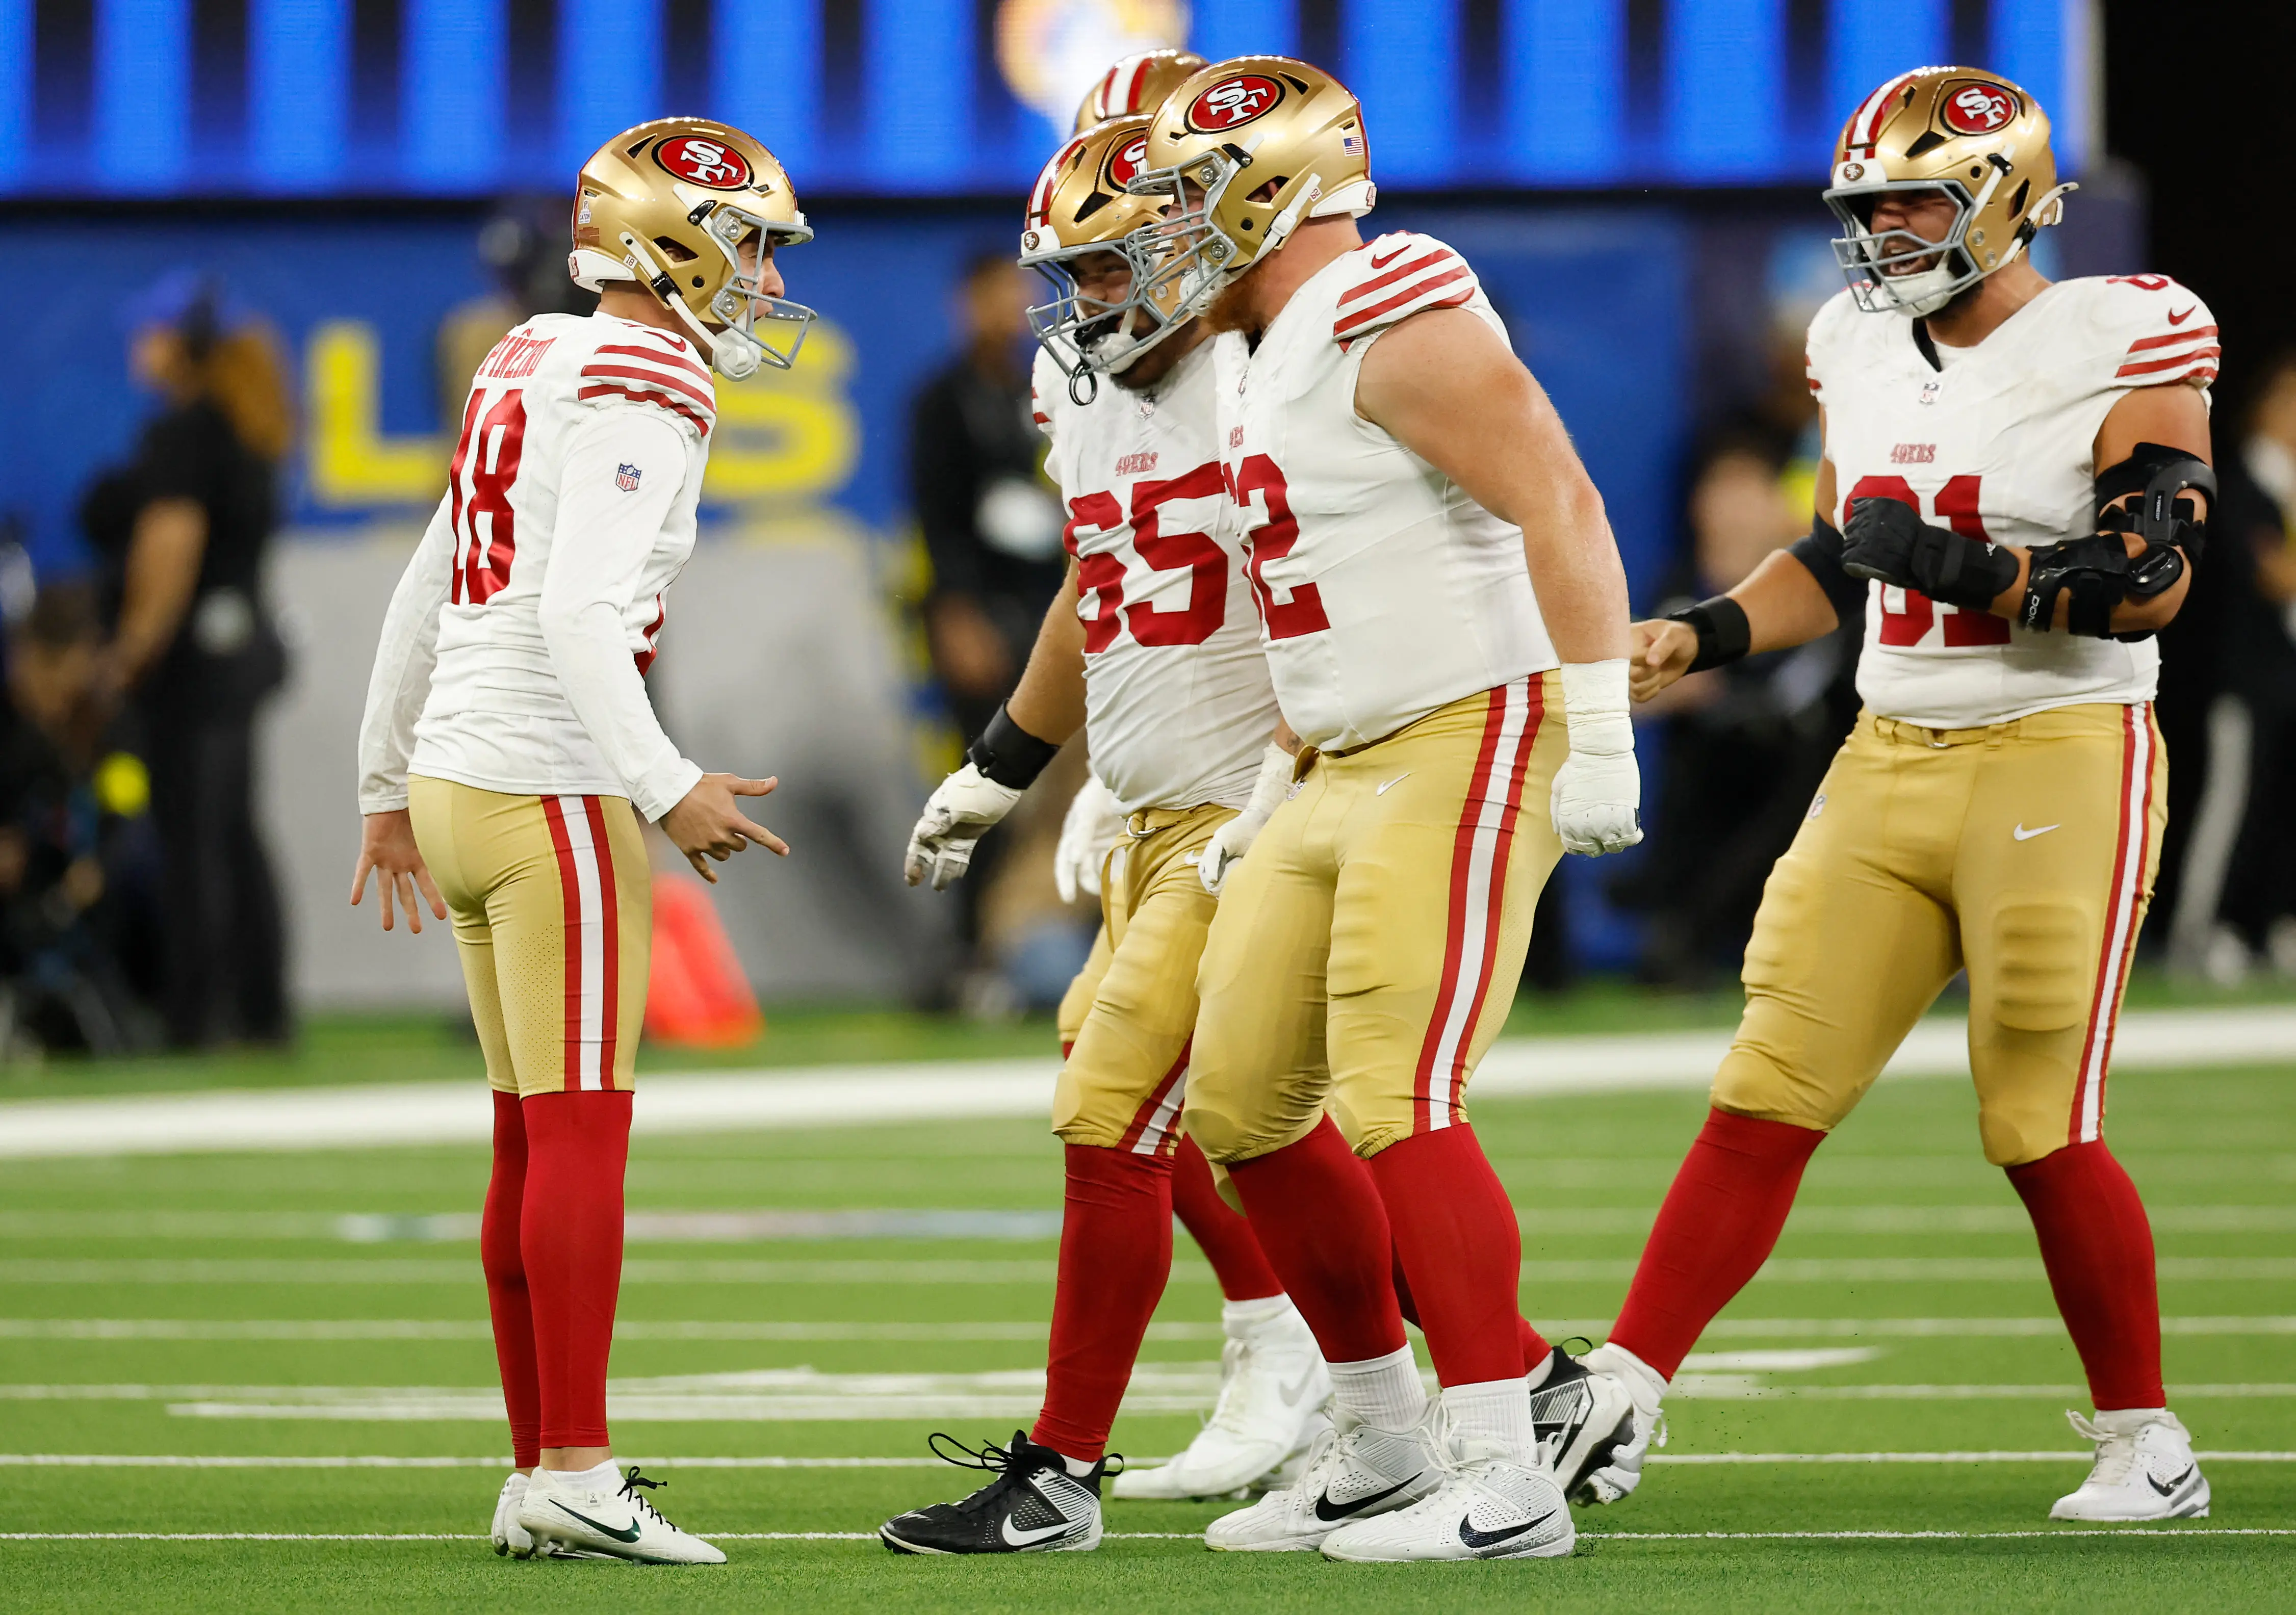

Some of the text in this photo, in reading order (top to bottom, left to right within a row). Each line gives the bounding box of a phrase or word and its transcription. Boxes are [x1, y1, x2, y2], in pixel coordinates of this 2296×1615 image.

[626, 256, 635, 266] 18
[1116, 452, 1158, 477] 49ERS
[1890, 443, 1937, 464] 49ERS
[617, 474, 636, 489] NFL
[450, 388, 527, 606] 18
[1063, 461, 1228, 654] 65
